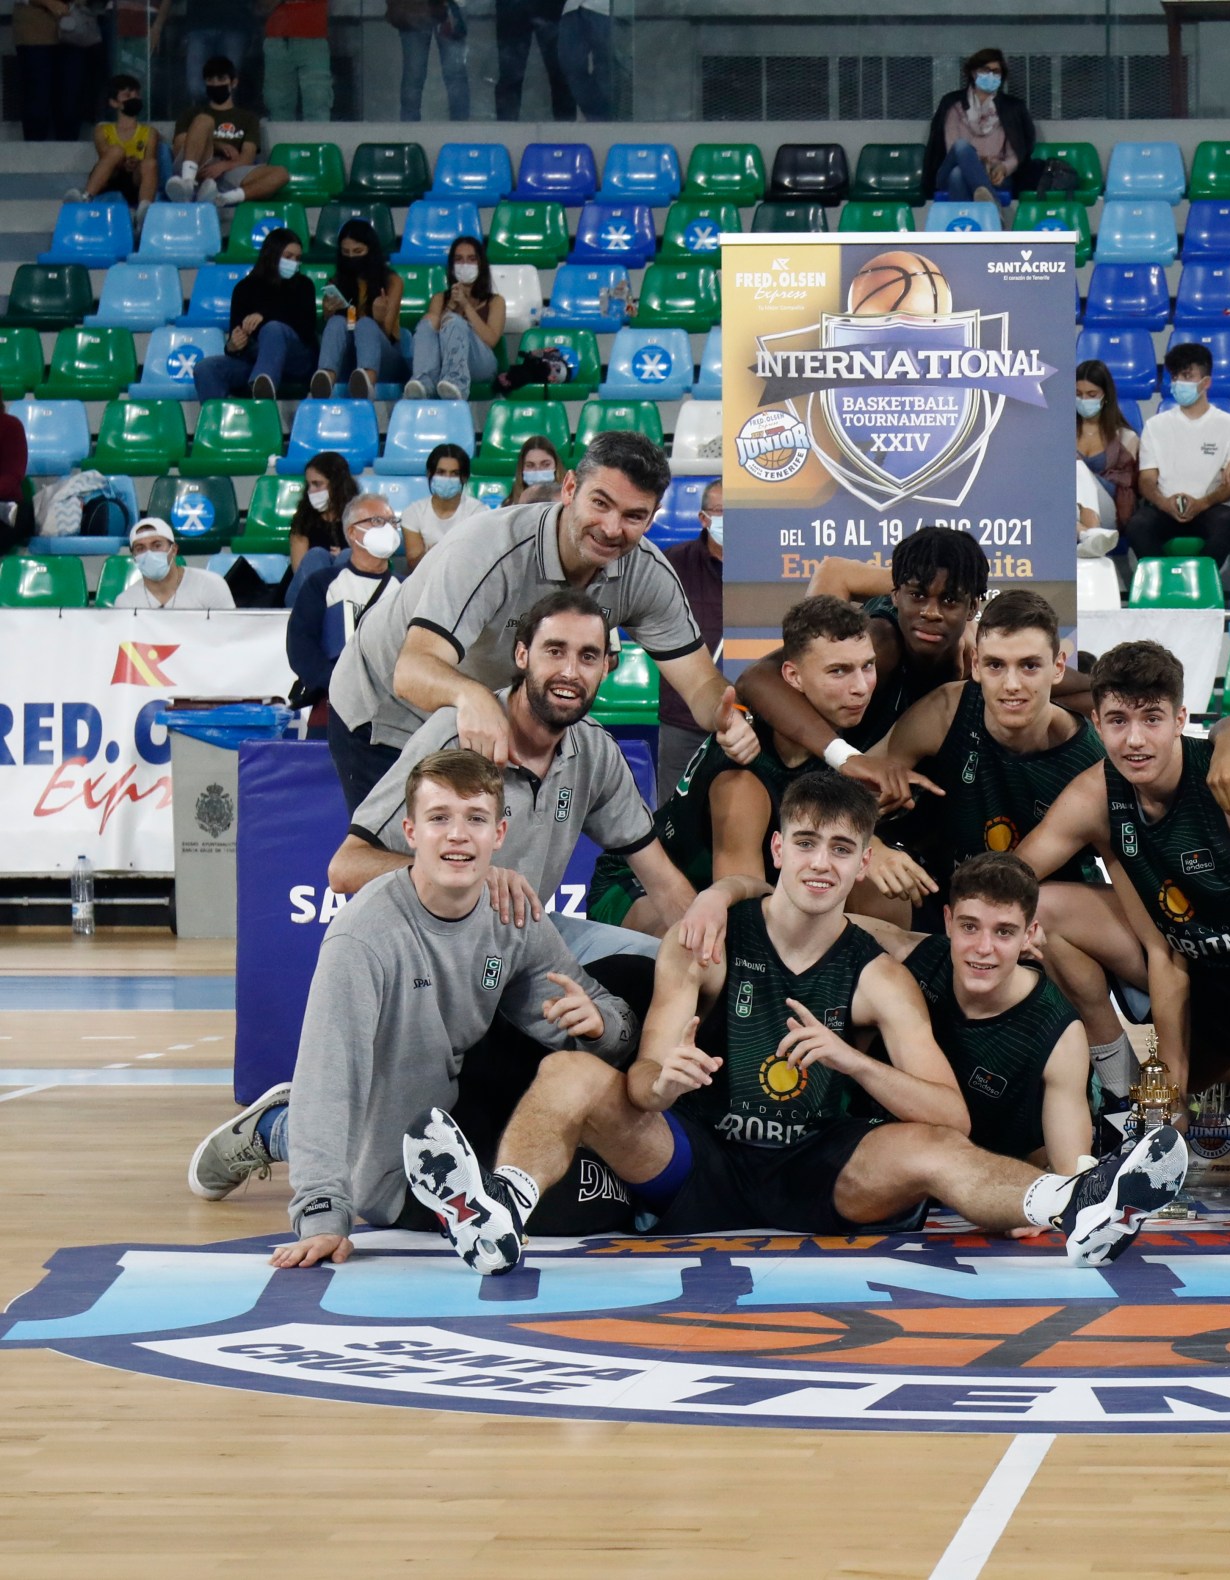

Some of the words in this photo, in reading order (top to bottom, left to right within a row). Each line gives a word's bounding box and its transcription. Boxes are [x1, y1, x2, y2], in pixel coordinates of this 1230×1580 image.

[756, 350, 1046, 379] INTERNATIONAL
[842, 396, 958, 411] BASKETBALL
[842, 413, 959, 426] TOURNAMENT
[735, 422, 810, 466] JUNIOR
[870, 433, 931, 452] XXIV
[764, 452, 804, 478] TENERIFE
[780, 530, 806, 546] DEL
[811, 519, 836, 546] 16
[844, 519, 872, 546] AL
[878, 518, 903, 546] 19
[978, 518, 1032, 546] 2021
[585, 1236, 890, 1254] XXIV
[216, 1342, 446, 1379] CRUZ
[458, 1372, 599, 1395] DE
[344, 1338, 646, 1382] SANTA
